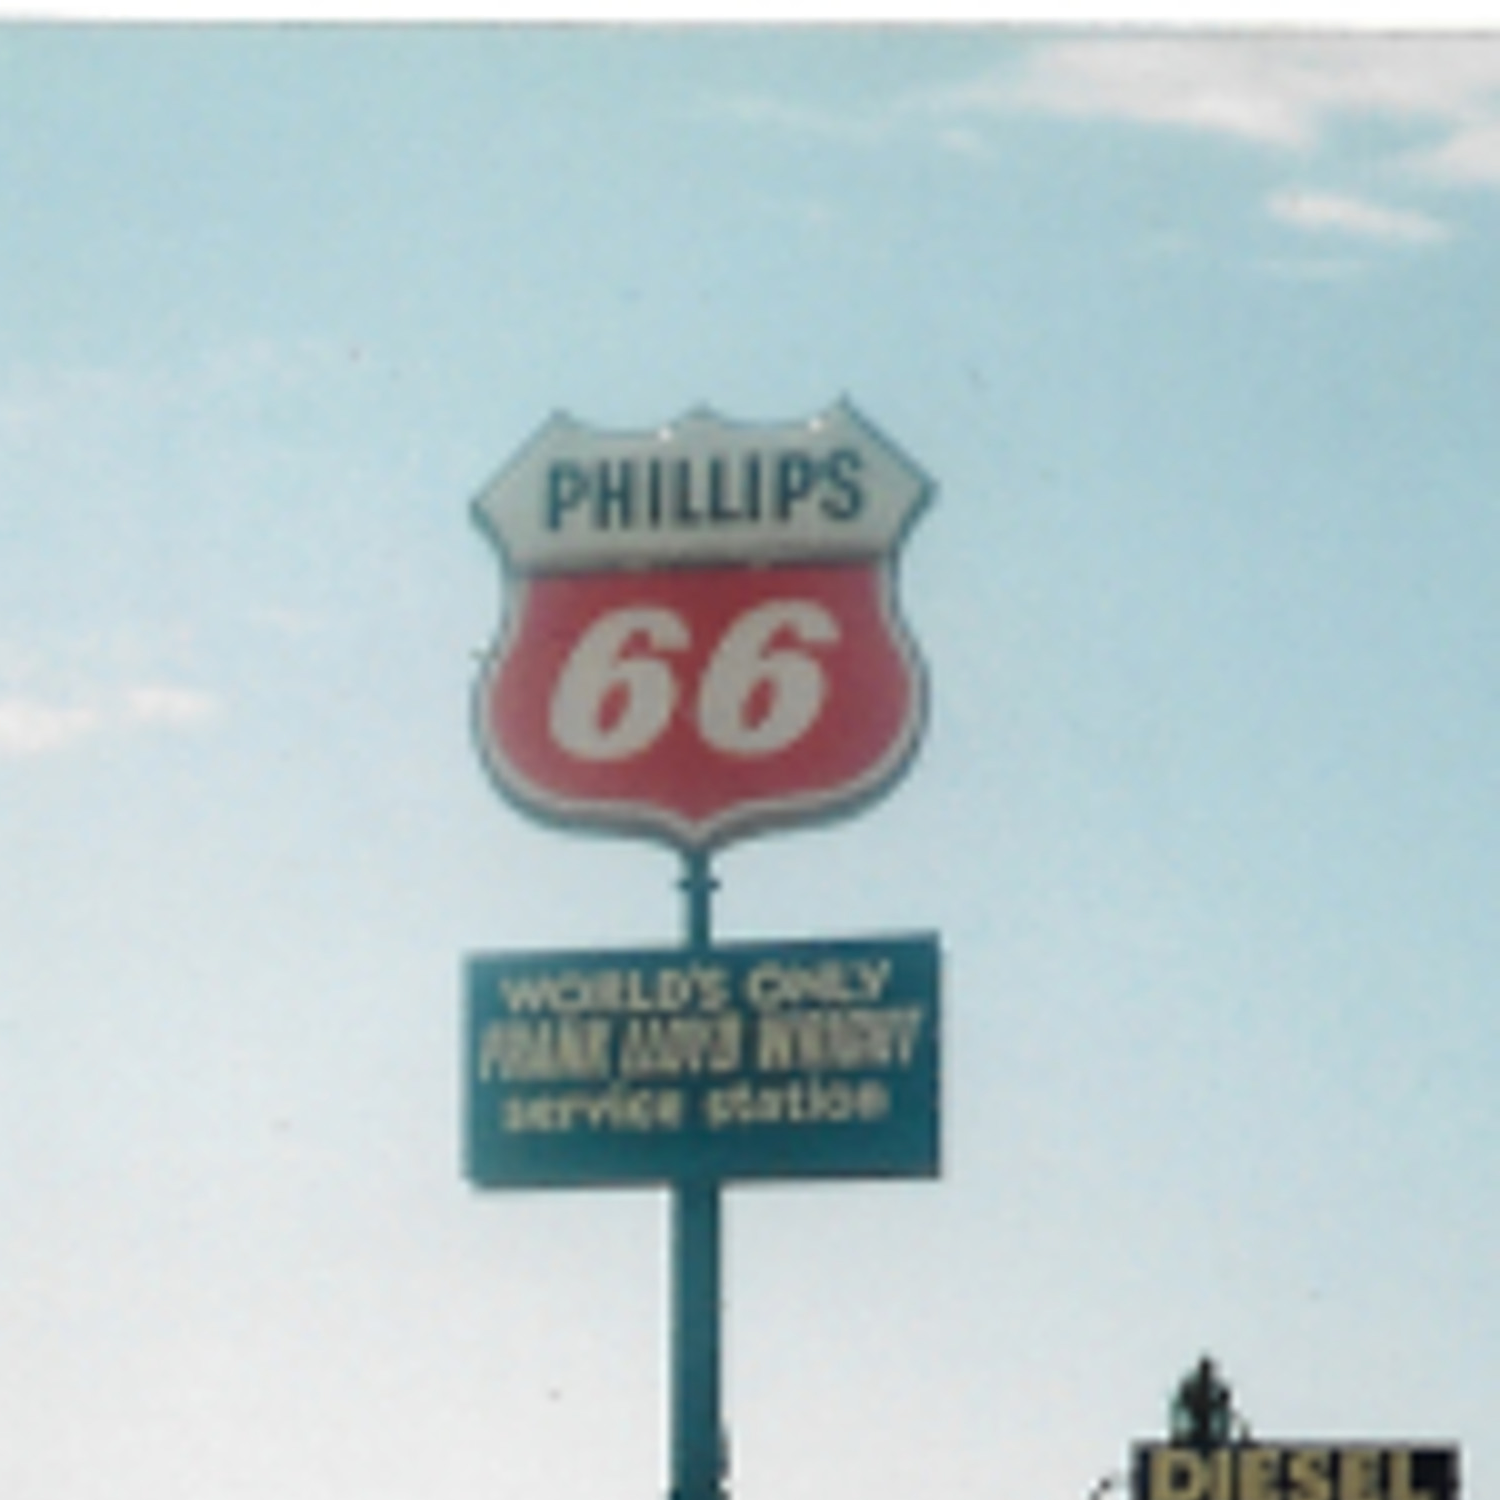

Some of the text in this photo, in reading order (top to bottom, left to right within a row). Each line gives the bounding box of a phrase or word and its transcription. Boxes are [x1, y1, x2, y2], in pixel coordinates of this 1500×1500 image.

[545, 449, 864, 531] PHILLIPS
[548, 598, 842, 762] 66
[499, 958, 891, 1013] WORLD'S ONLY
